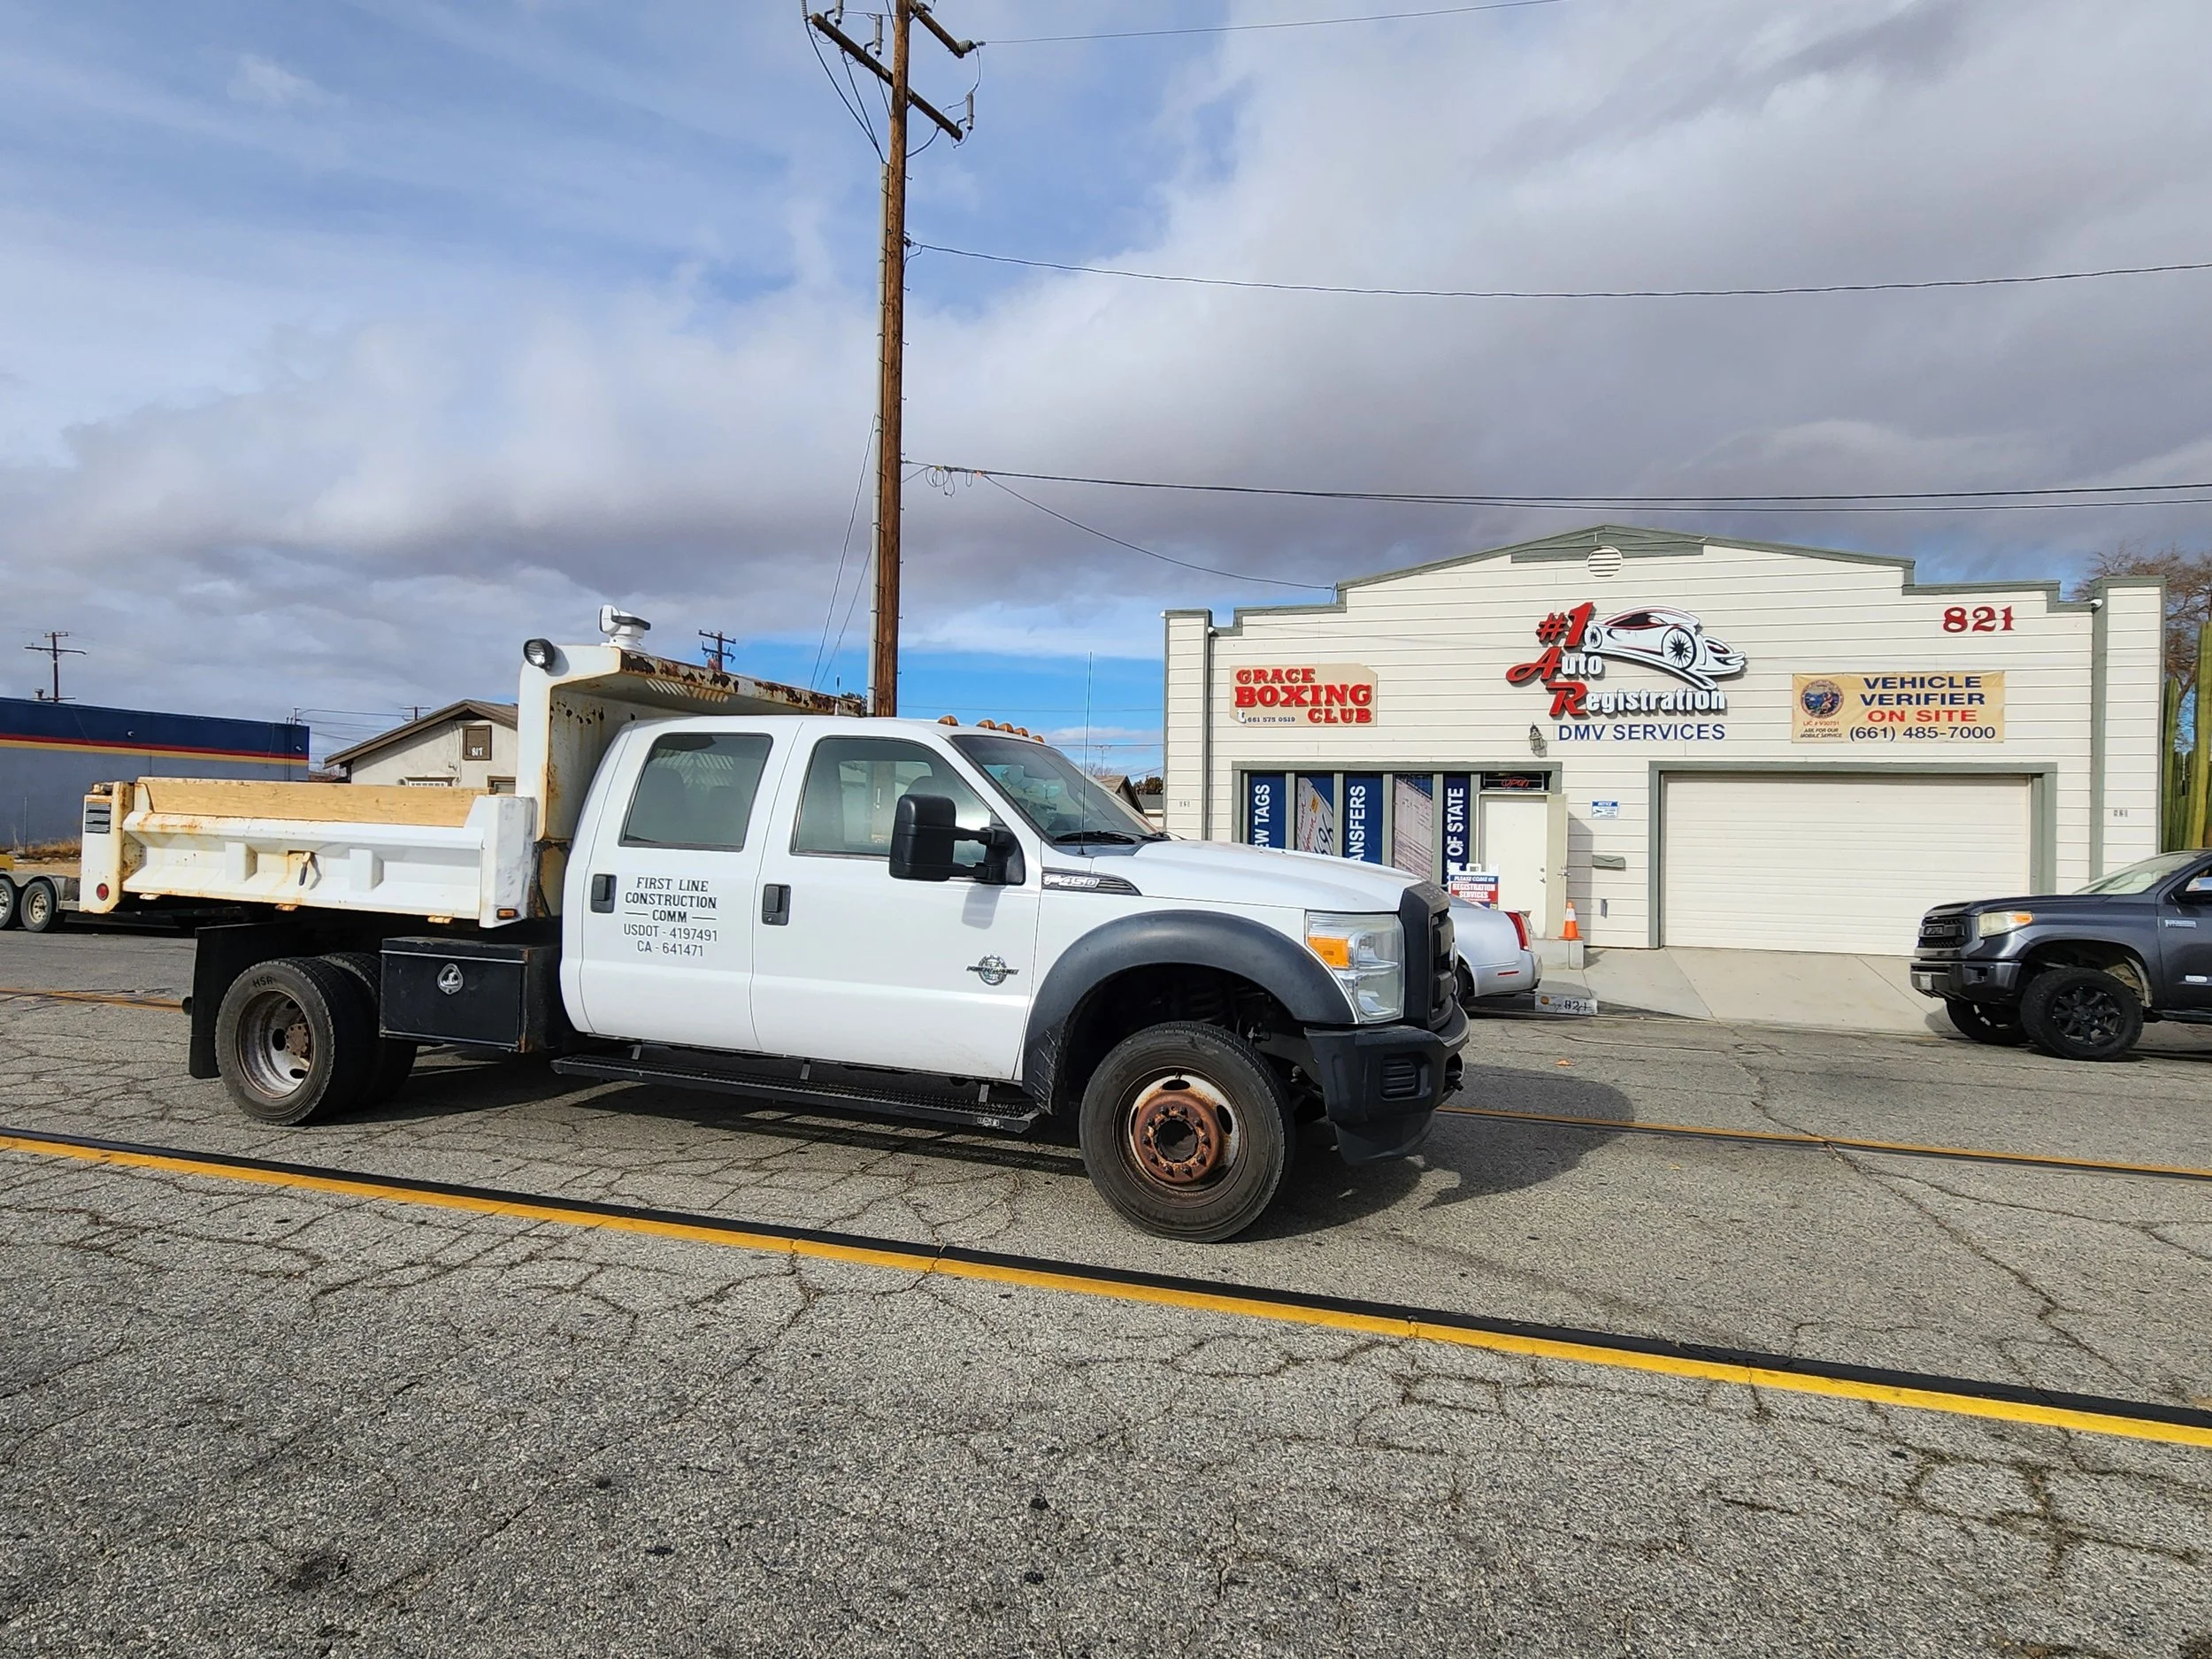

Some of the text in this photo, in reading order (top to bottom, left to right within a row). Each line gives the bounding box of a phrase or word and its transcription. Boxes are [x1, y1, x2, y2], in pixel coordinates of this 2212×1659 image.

[1536, 602, 1594, 648] #1
[1943, 605, 2016, 634] 821
[1506, 646, 1603, 683] Auto
[1236, 668, 1316, 684] GRACE
[1863, 676, 1982, 689] VEHICLE
[1234, 684, 1372, 708] BOXING
[1546, 681, 1726, 717] Registration
[1860, 693, 1985, 706] VERIFIER
[1308, 708, 1372, 724] CLUB
[1867, 709, 1978, 723] ON SITE
[1559, 723, 1725, 741] DMV SERVICES
[1849, 726, 1996, 742] (661) 485-7000
[1255, 784, 1271, 823] TAGS
[1447, 787, 1464, 833] STATE
[1447, 835, 1464, 856] OF
[636, 877, 710, 893] FIRST LINE
[625, 892, 718, 910] CONSTRUCTION
[652, 910, 687, 923] COMM
[623, 924, 659, 937] USDOT
[669, 926, 718, 942] 4197491
[637, 941, 652, 953] CA
[663, 943, 704, 957] 641471
